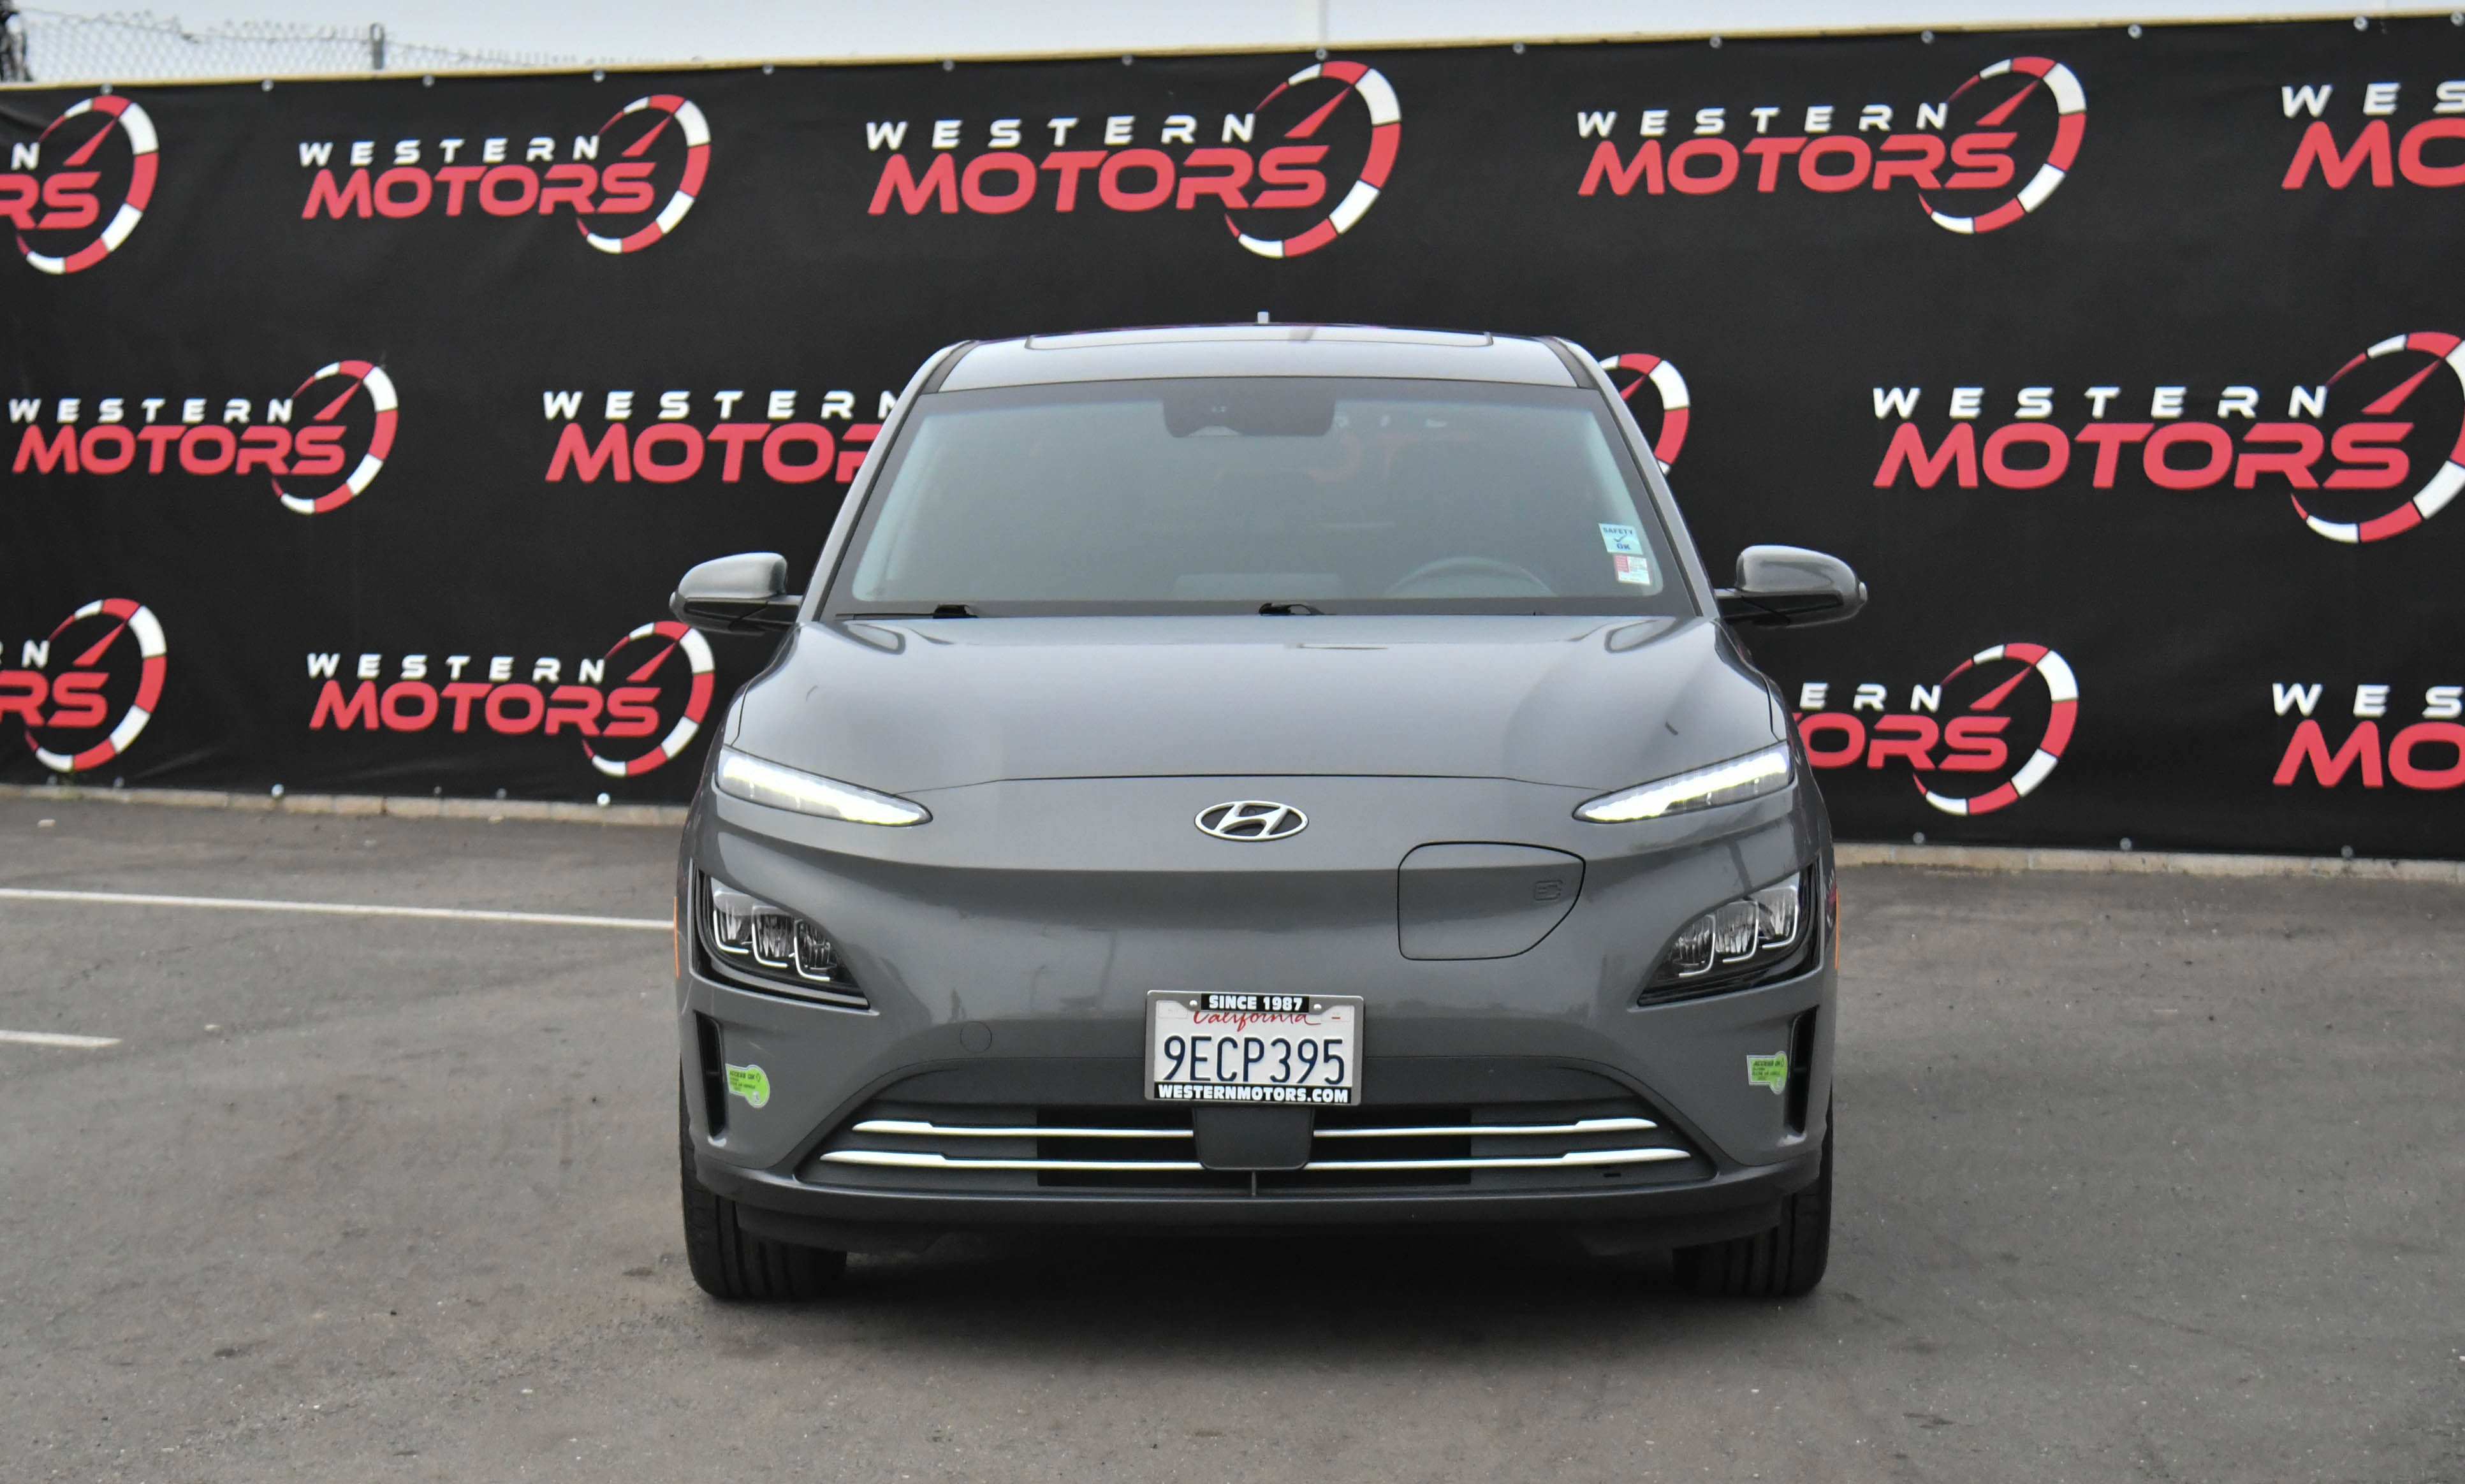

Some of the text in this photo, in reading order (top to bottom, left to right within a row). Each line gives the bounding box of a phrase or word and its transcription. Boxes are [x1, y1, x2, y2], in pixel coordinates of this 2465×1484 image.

[866, 113, 1255, 150] WESTERN
[1577, 102, 1948, 137] WESTERN
[299, 135, 599, 166] WESTERN
[1577, 131, 2018, 196] MOTORS
[301, 161, 656, 220] MOTORS
[867, 144, 1330, 215] MOTORS
[9, 398, 293, 423] WESTERN
[1872, 385, 2327, 418] WESTERN
[12, 424, 347, 476] MOTORS
[1873, 421, 2414, 490] MOTORS
[307, 653, 605, 683] WESTERN
[309, 679, 661, 738] MOTORS
[1791, 711, 2011, 771] ORS
[1208, 994, 1303, 1011] SINCE 1987
[1192, 1011, 1322, 1032] California
[1162, 1035, 1345, 1084] 9ECP395
[1158, 1084, 1349, 1103] WESTERNMOTORS.COM
